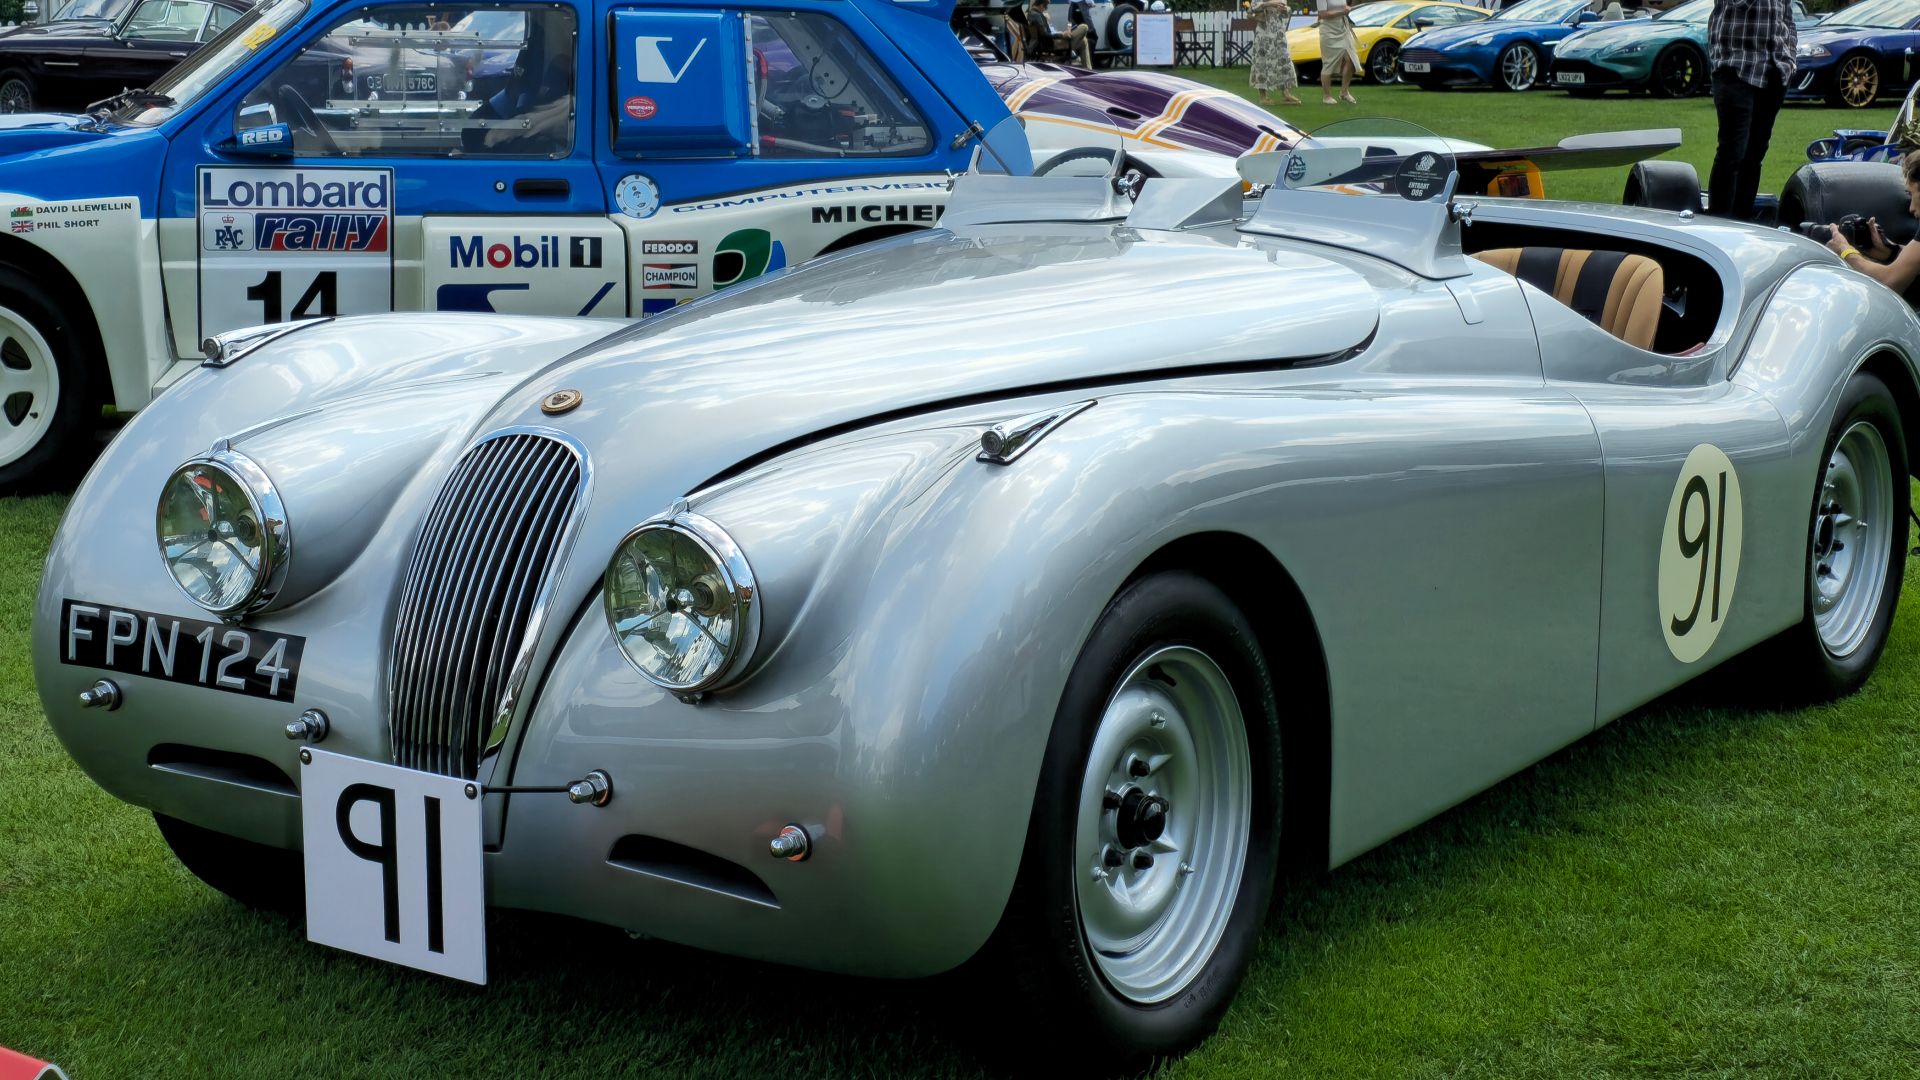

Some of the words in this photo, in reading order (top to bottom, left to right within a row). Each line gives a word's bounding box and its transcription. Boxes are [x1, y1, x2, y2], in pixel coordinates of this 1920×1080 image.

[242, 130, 283, 144] RED
[203, 172, 388, 208] Lombard
[1408, 181, 1430, 190] ENTRANT
[36, 205, 69, 214] DAVID
[72, 202, 132, 212] LLEWELLIN
[37, 221, 61, 229] PHIL
[64, 219, 100, 228] SHORT
[258, 215, 384, 251] rally
[644, 243, 694, 253] FERODO
[449, 235, 560, 269] Mobil
[645, 271, 696, 282] CHAMPION
[247, 271, 337, 324] 14
[1670, 471, 1727, 637] 91
[68, 604, 180, 677] FPN
[196, 626, 290, 696] 124
[336, 782, 445, 955] 91
